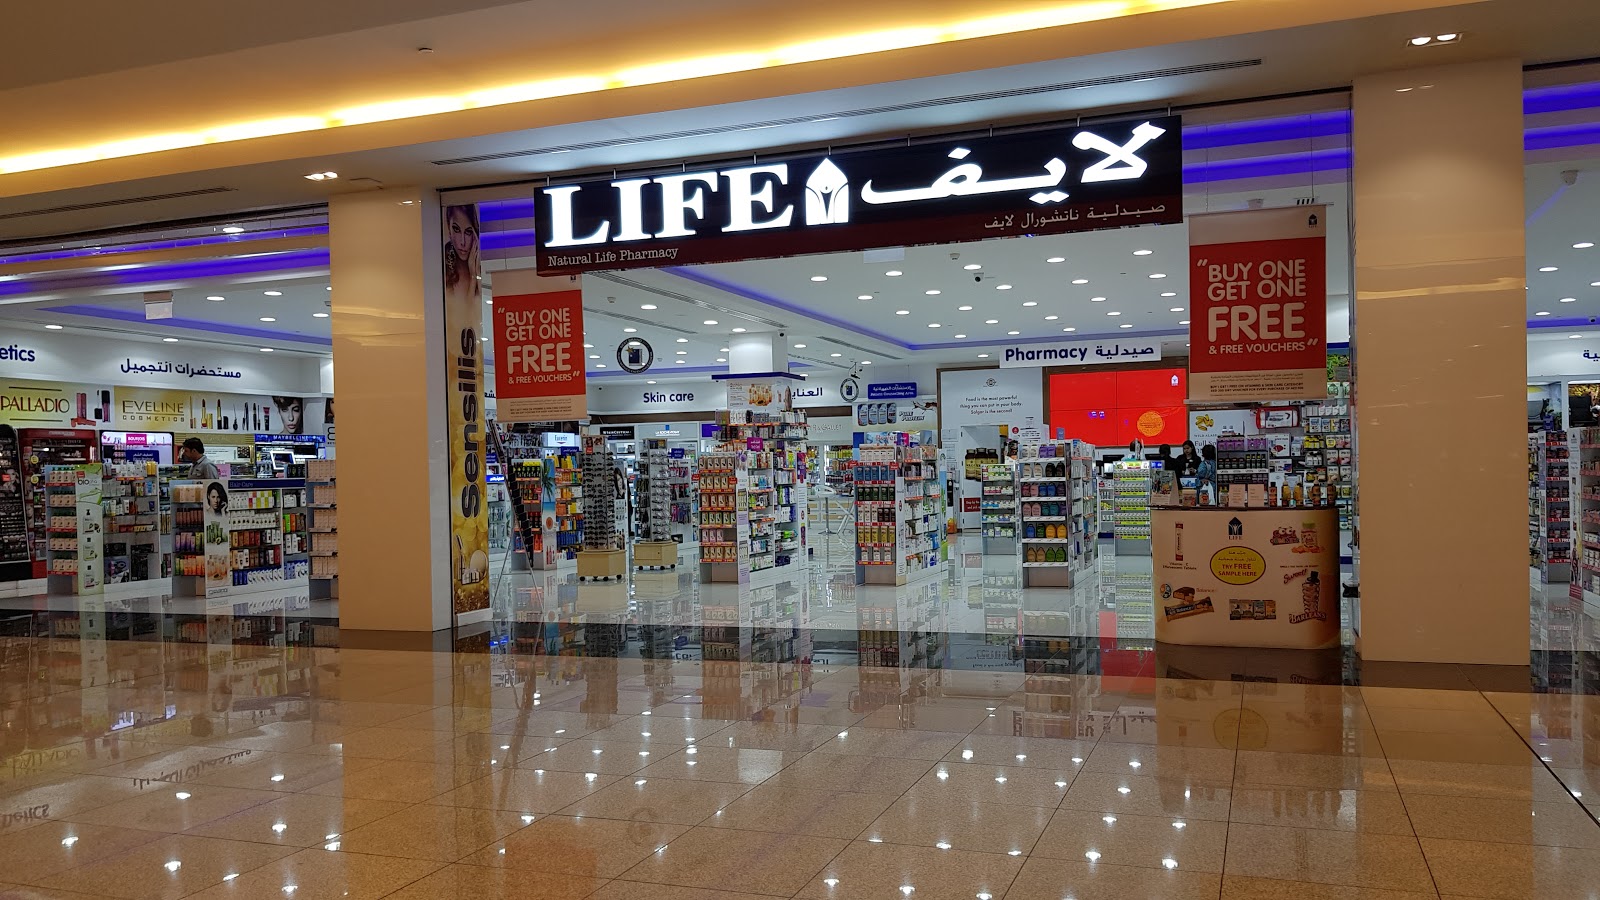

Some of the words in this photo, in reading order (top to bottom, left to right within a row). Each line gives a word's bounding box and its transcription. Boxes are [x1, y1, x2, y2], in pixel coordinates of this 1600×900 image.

[861, 121, 1167, 205] لايف
[543, 163, 794, 248] LIFE
[1087, 204, 1166, 220] صيدلية
[984, 214, 1014, 229] لايف
[1021, 208, 1079, 229] ناتشورال
[548, 253, 592, 266] Natural
[595, 252, 616, 264] Life
[620, 248, 678, 260] Pharmacy
[1259, 259, 1306, 279] ONE
[1208, 281, 1250, 301] GET
[1257, 278, 1306, 299] ONE
[540, 308, 570, 324] ONE
[1208, 302, 1305, 342] FREE
[506, 326, 535, 342] GET
[539, 322, 572, 340] ONE
[1006, 348, 1088, 362] Pharmacy
[1096, 344, 1154, 360] صيدلية
[1209, 346, 1217, 354] &
[1220, 345, 1244, 354] FREE
[121, 358, 172, 374] التجميل
[507, 342, 571, 374] FREE
[175, 364, 242, 378] مستحضرات
[643, 392, 666, 403] Skin
[670, 393, 694, 402] care
[792, 387, 822, 399] العناي
[0, 396, 70, 413] PALLADIO
[122, 400, 184, 413] EVELINE
